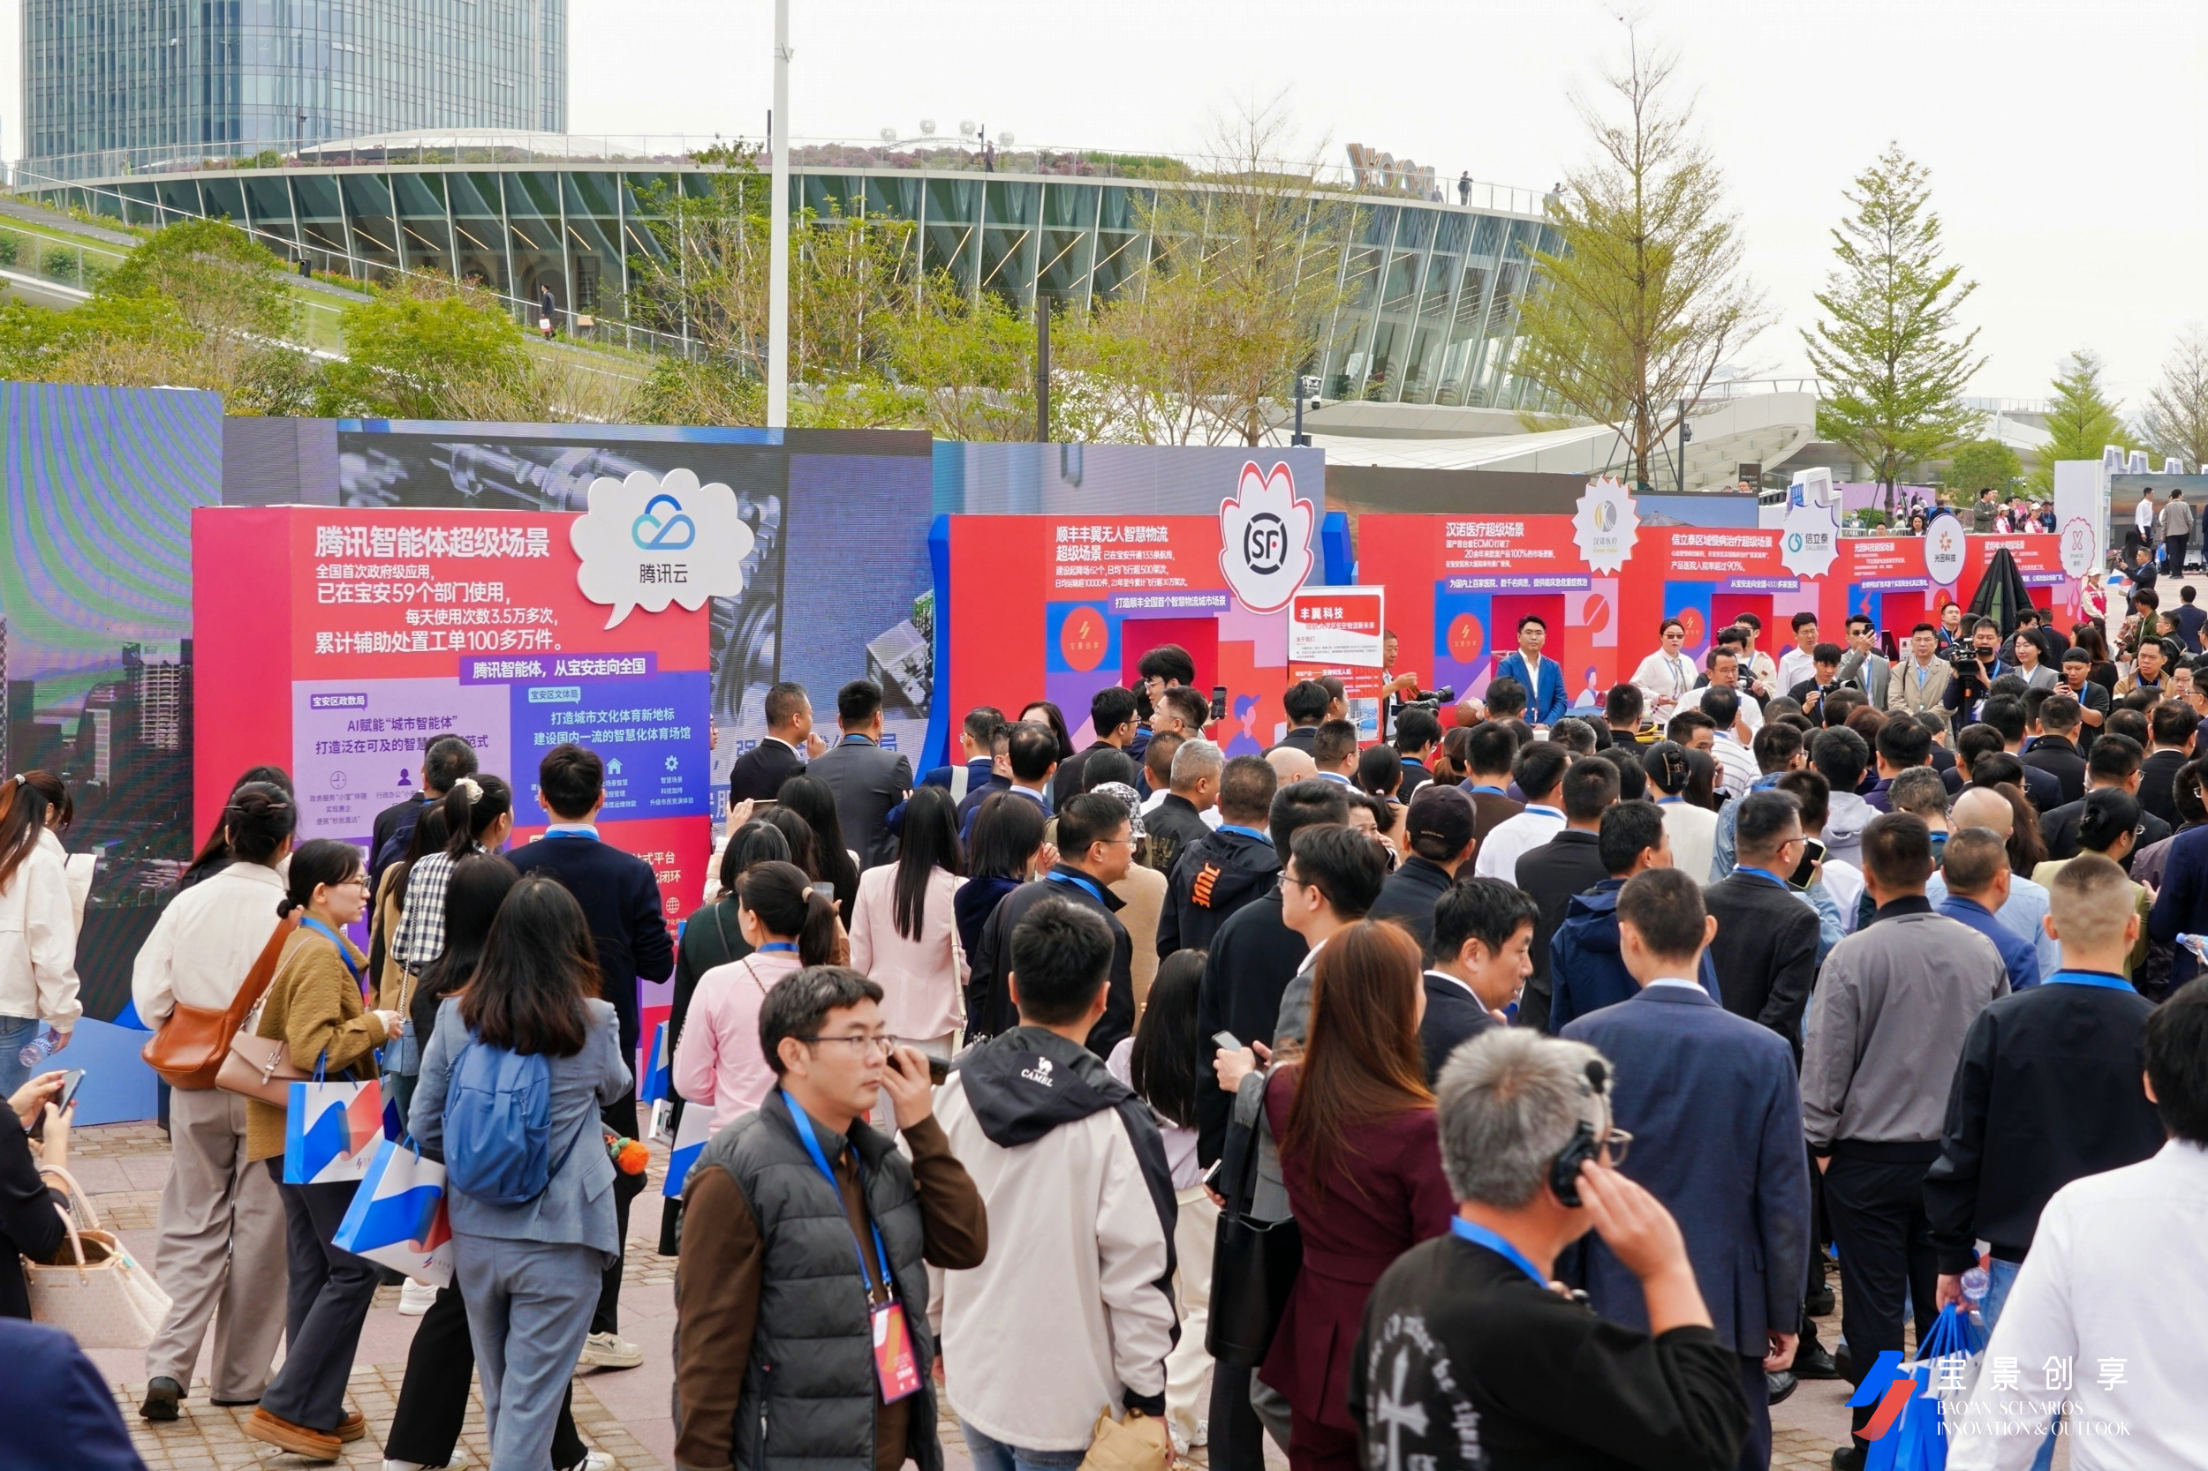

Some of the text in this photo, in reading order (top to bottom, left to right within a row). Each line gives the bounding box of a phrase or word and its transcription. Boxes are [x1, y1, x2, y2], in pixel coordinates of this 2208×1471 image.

[1055, 526, 1169, 543] 顺丰丰翼无人智慧物流
[1446, 522, 1525, 538] 汉诺医疗超级场景
[315, 525, 550, 558] 腾讯智能体超级场景
[1252, 529, 1279, 560] SF
[1593, 537, 1618, 546] 汉诺医疗
[1805, 533, 1829, 545] 信立泰
[1055, 545, 1102, 562] 超级场景
[639, 563, 689, 584] 腾讯云
[1115, 596, 1226, 609] 打造顺丰全国首个智慧物流城市场景
[1300, 607, 1343, 620] 丰翼科技
[314, 628, 562, 655] 累计辅助处置工单100多万件。
[472, 657, 646, 680] 腾讯智能体，从宝安走向全国
[312, 695, 366, 708] 宝安区政数局
[530, 689, 580, 700] 宝安区文体局
[551, 708, 676, 726] 打造城市文化体育新地标
[533, 726, 692, 746] 建设国内一流的智慧化体育场馆
[1021, 1068, 1053, 1087] CAMEL
